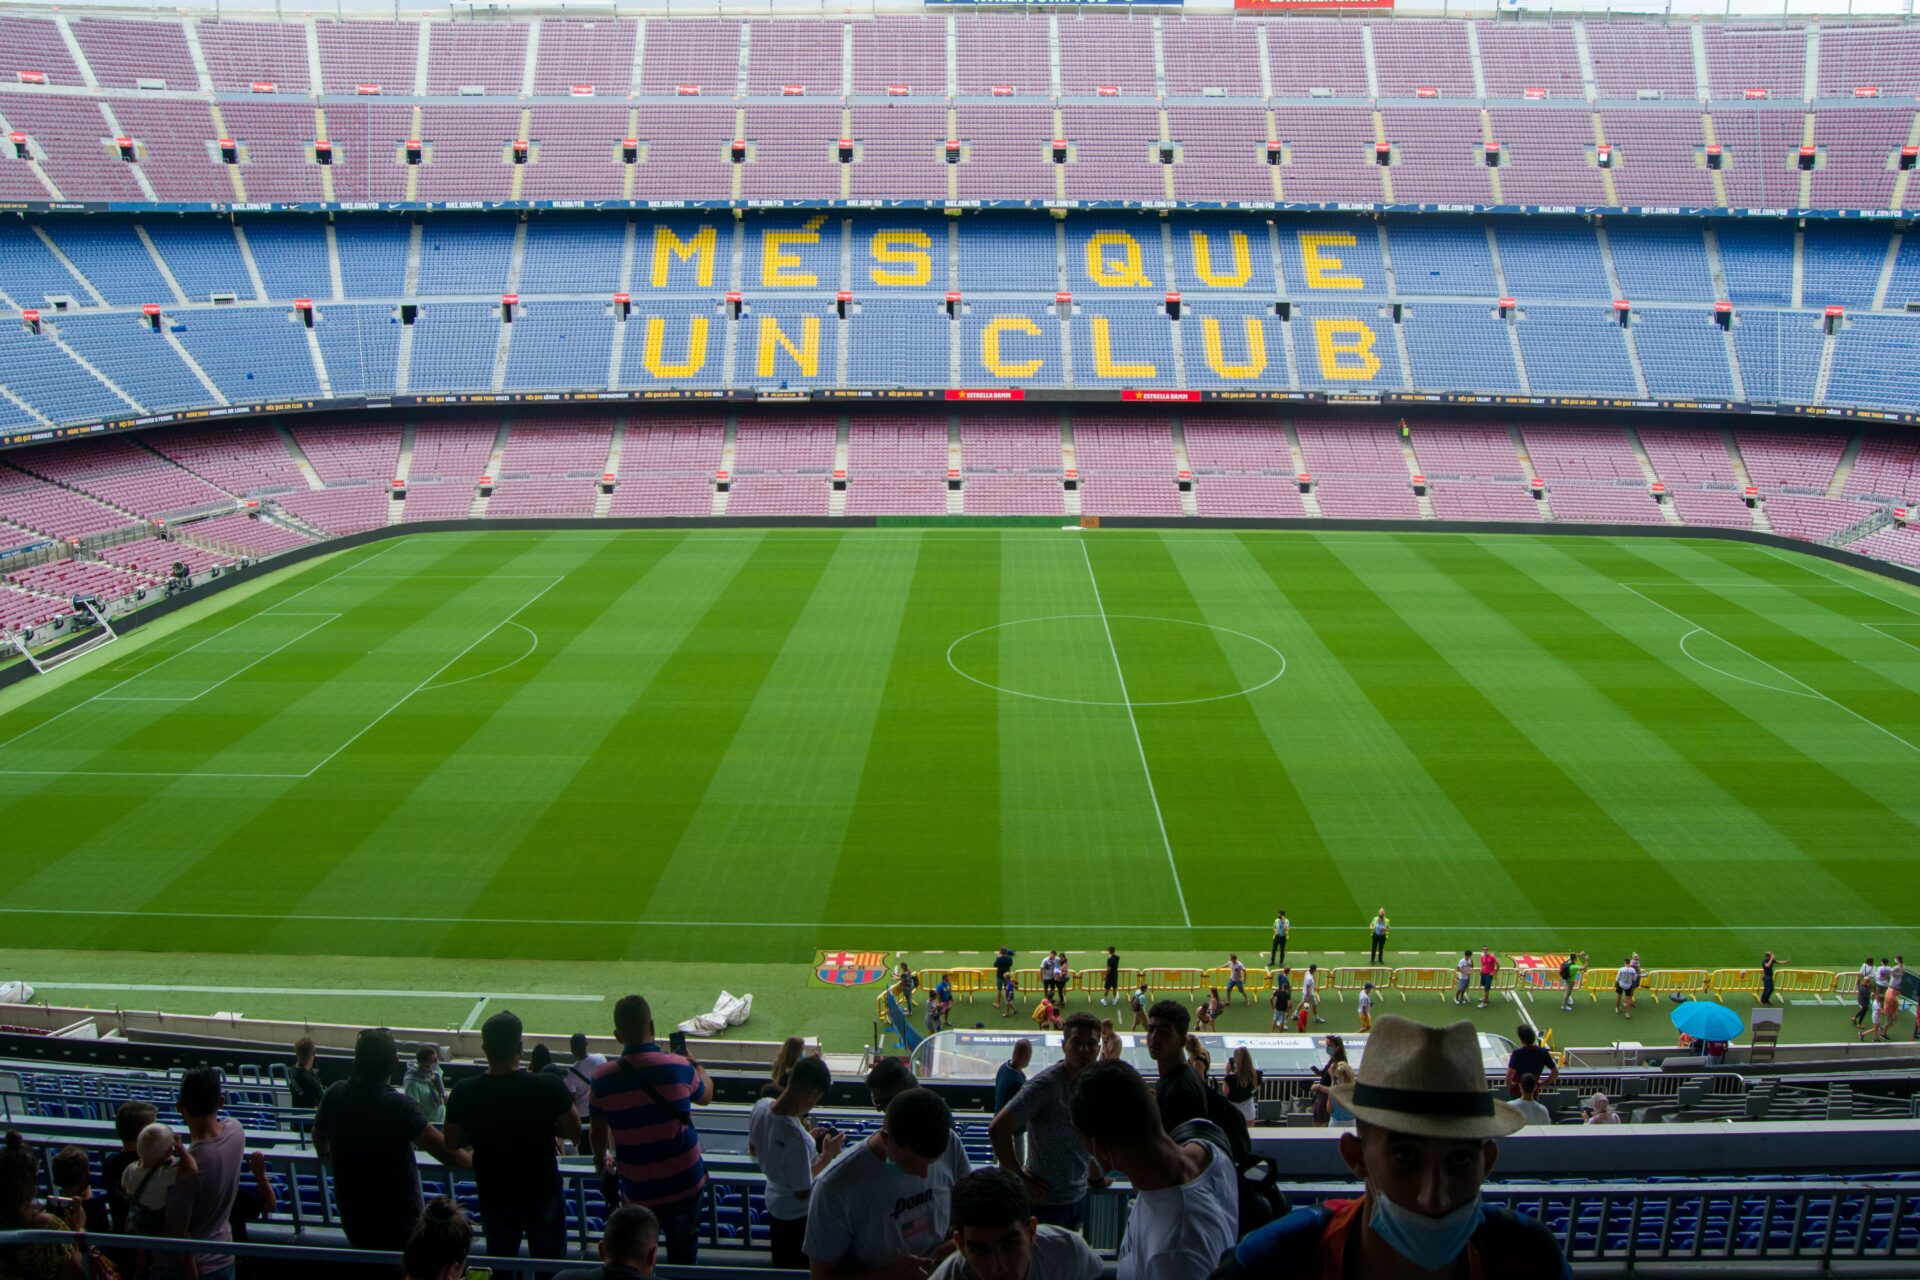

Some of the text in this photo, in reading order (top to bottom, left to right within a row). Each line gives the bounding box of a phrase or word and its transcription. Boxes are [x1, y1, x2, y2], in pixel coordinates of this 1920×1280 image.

[650, 214, 1364, 289] MÉS QUE
[644, 316, 1381, 380] UN CLUB
